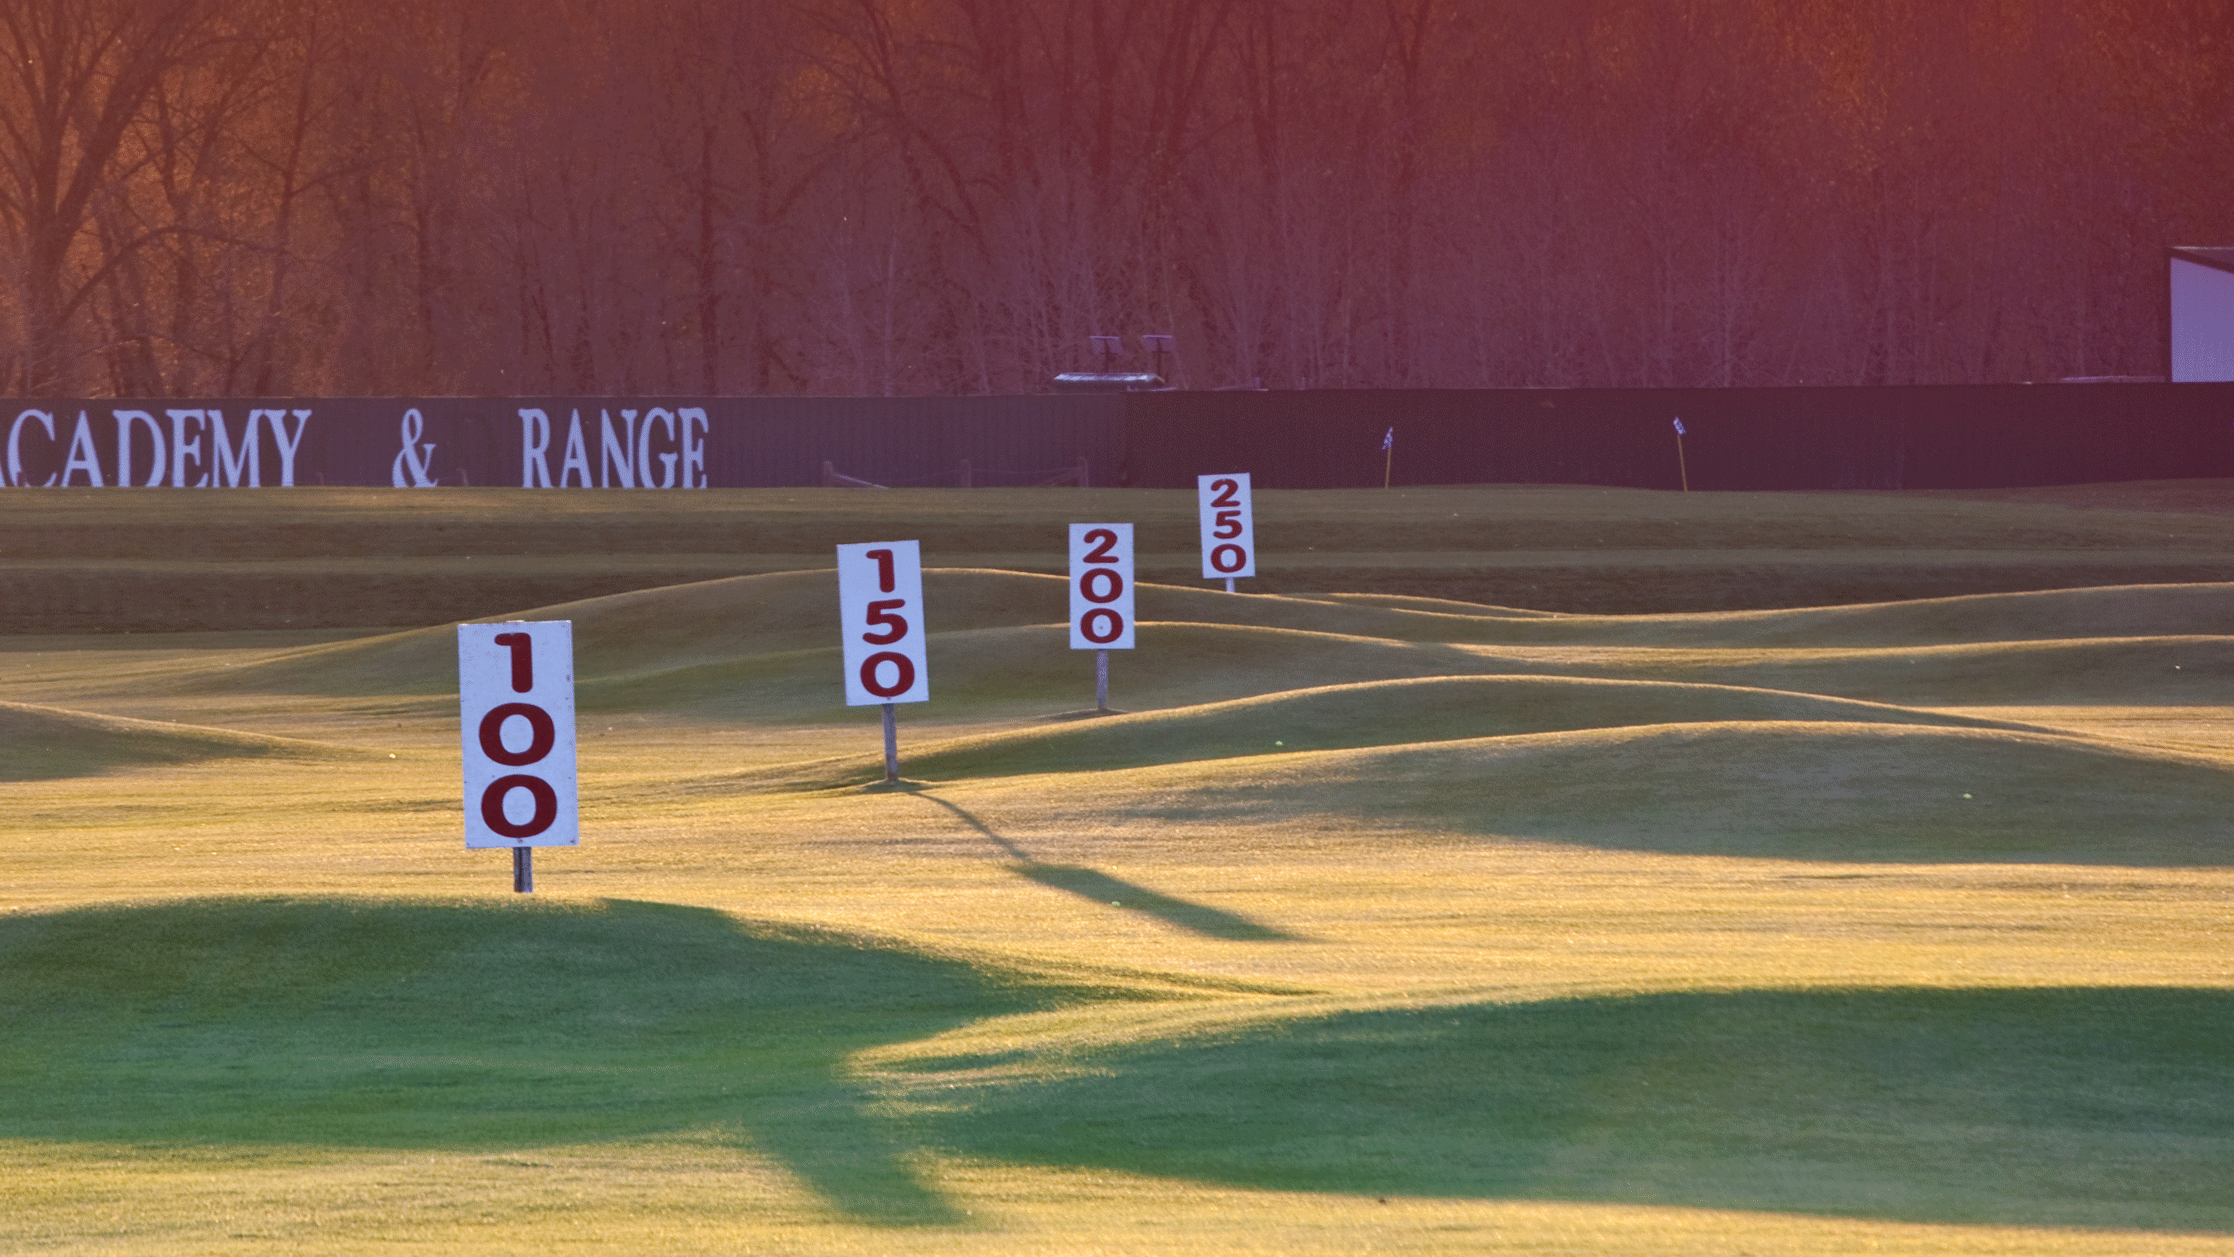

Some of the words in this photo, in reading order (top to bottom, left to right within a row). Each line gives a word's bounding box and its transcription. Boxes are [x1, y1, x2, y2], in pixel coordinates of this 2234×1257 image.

[0, 408, 312, 488] CADEMY
[391, 408, 438, 488] &
[518, 407, 709, 489] RANGE
[1211, 478, 1247, 573] 250
[860, 549, 915, 698] 150
[1080, 529, 1124, 644] 200
[478, 632, 557, 838] 100
